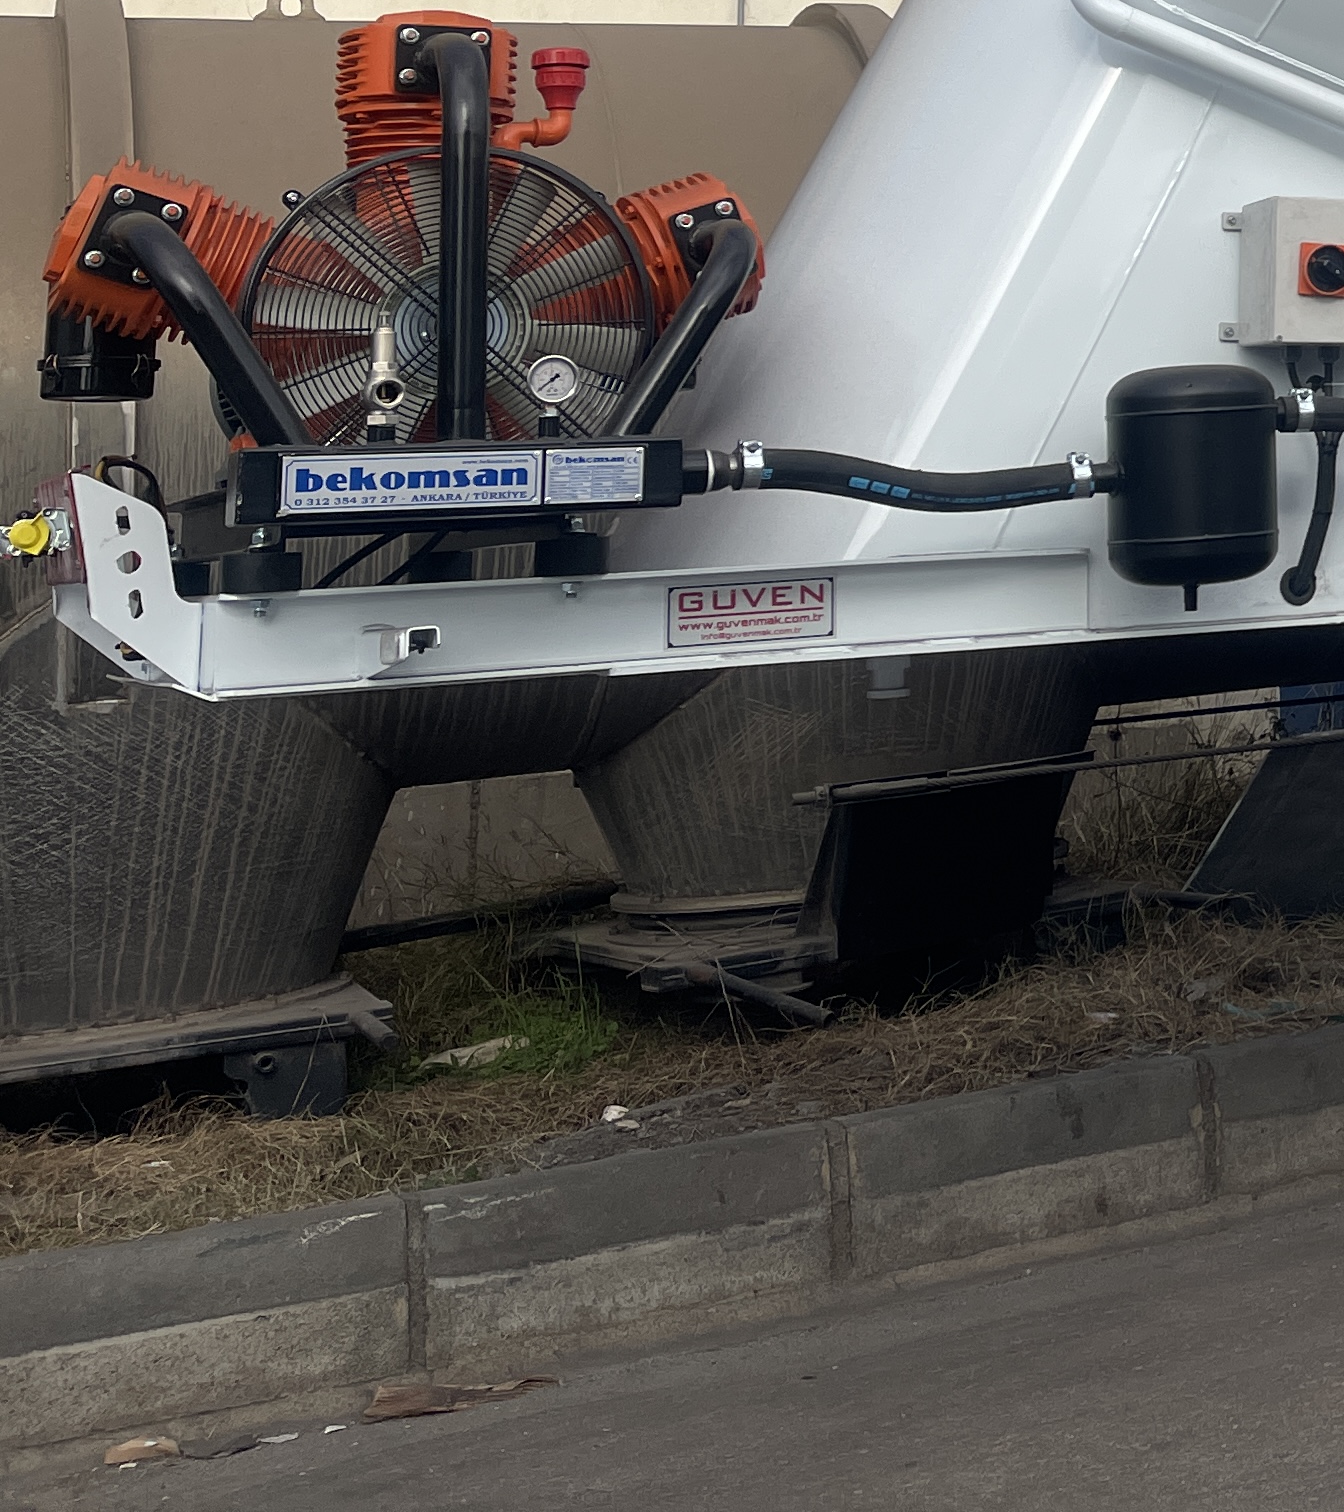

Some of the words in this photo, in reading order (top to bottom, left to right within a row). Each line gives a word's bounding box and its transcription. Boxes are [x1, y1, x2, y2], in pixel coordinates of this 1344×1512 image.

[295, 467, 528, 493] bekomsan
[294, 498, 302, 506] 0
[306, 497, 330, 506] 312
[333, 496, 357, 505] 354
[361, 496, 377, 504] 37
[380, 495, 396, 504] 27
[411, 493, 463, 503] ANKARA
[473, 490, 528, 501] TÜRKİYE
[678, 583, 825, 613] GÜVEN
[678, 613, 825, 632] www.guvenmak.com.tr
[700, 627, 803, 641] info@guvenmak.com.tr
